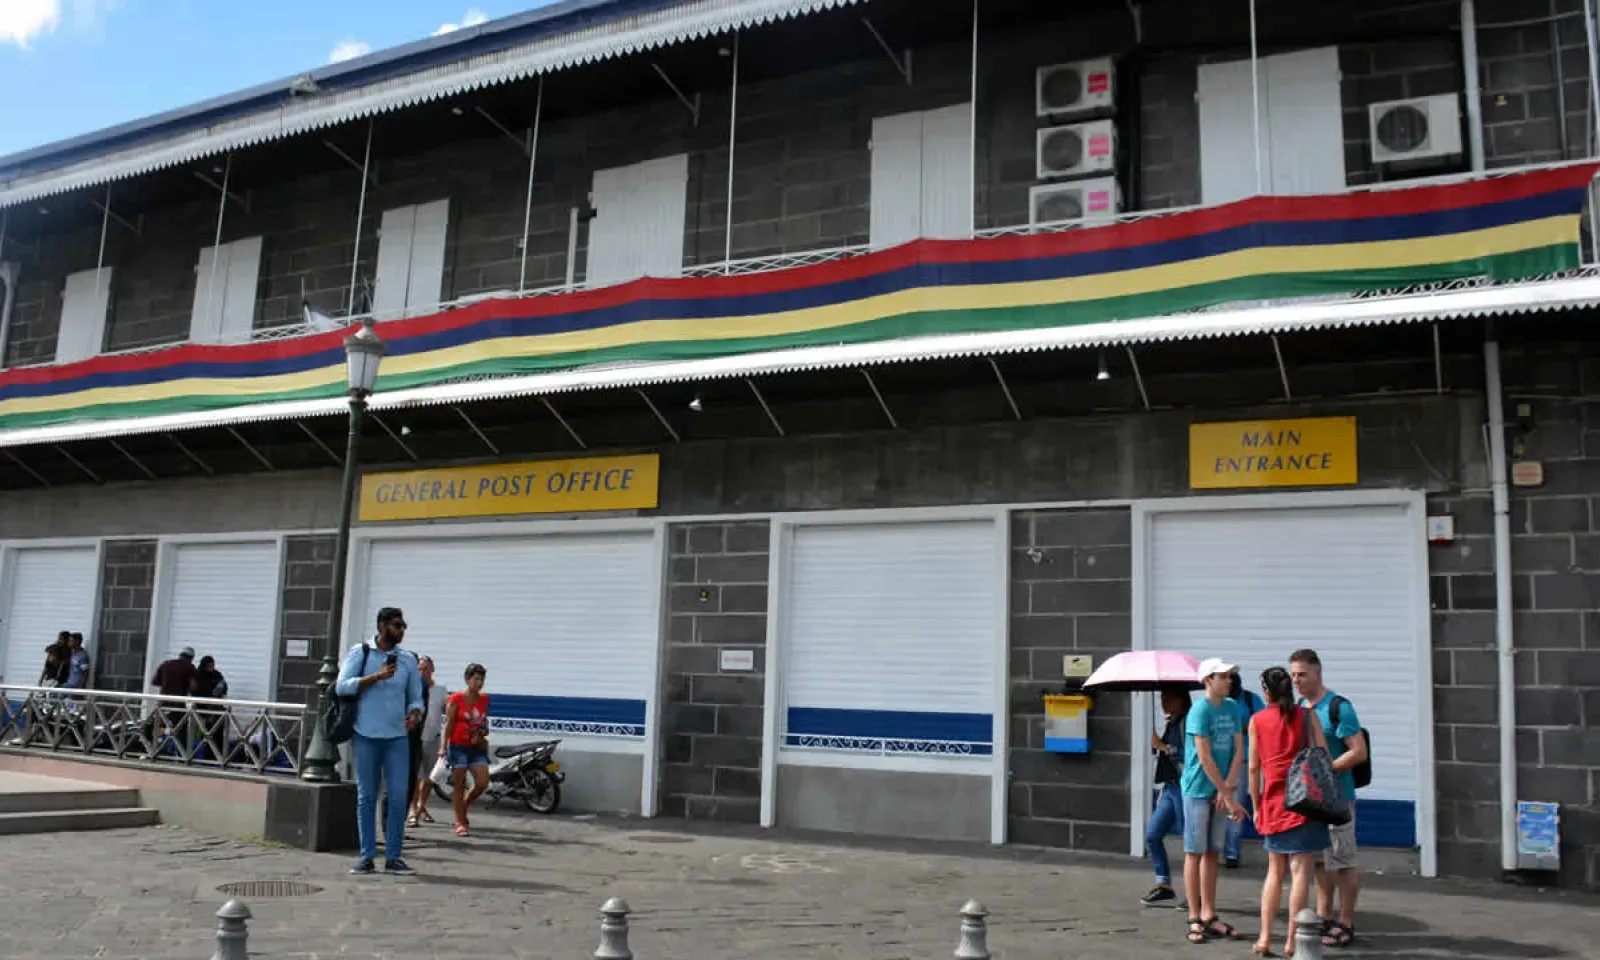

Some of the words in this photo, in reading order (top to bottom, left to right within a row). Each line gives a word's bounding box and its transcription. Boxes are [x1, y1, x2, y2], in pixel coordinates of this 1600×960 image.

[1241, 429, 1302, 447] MAIN
[1214, 452, 1333, 473] ENTRANCE
[376, 480, 469, 503] GENERAL
[477, 474, 536, 497] POST
[547, 469, 635, 493] OFFICE
